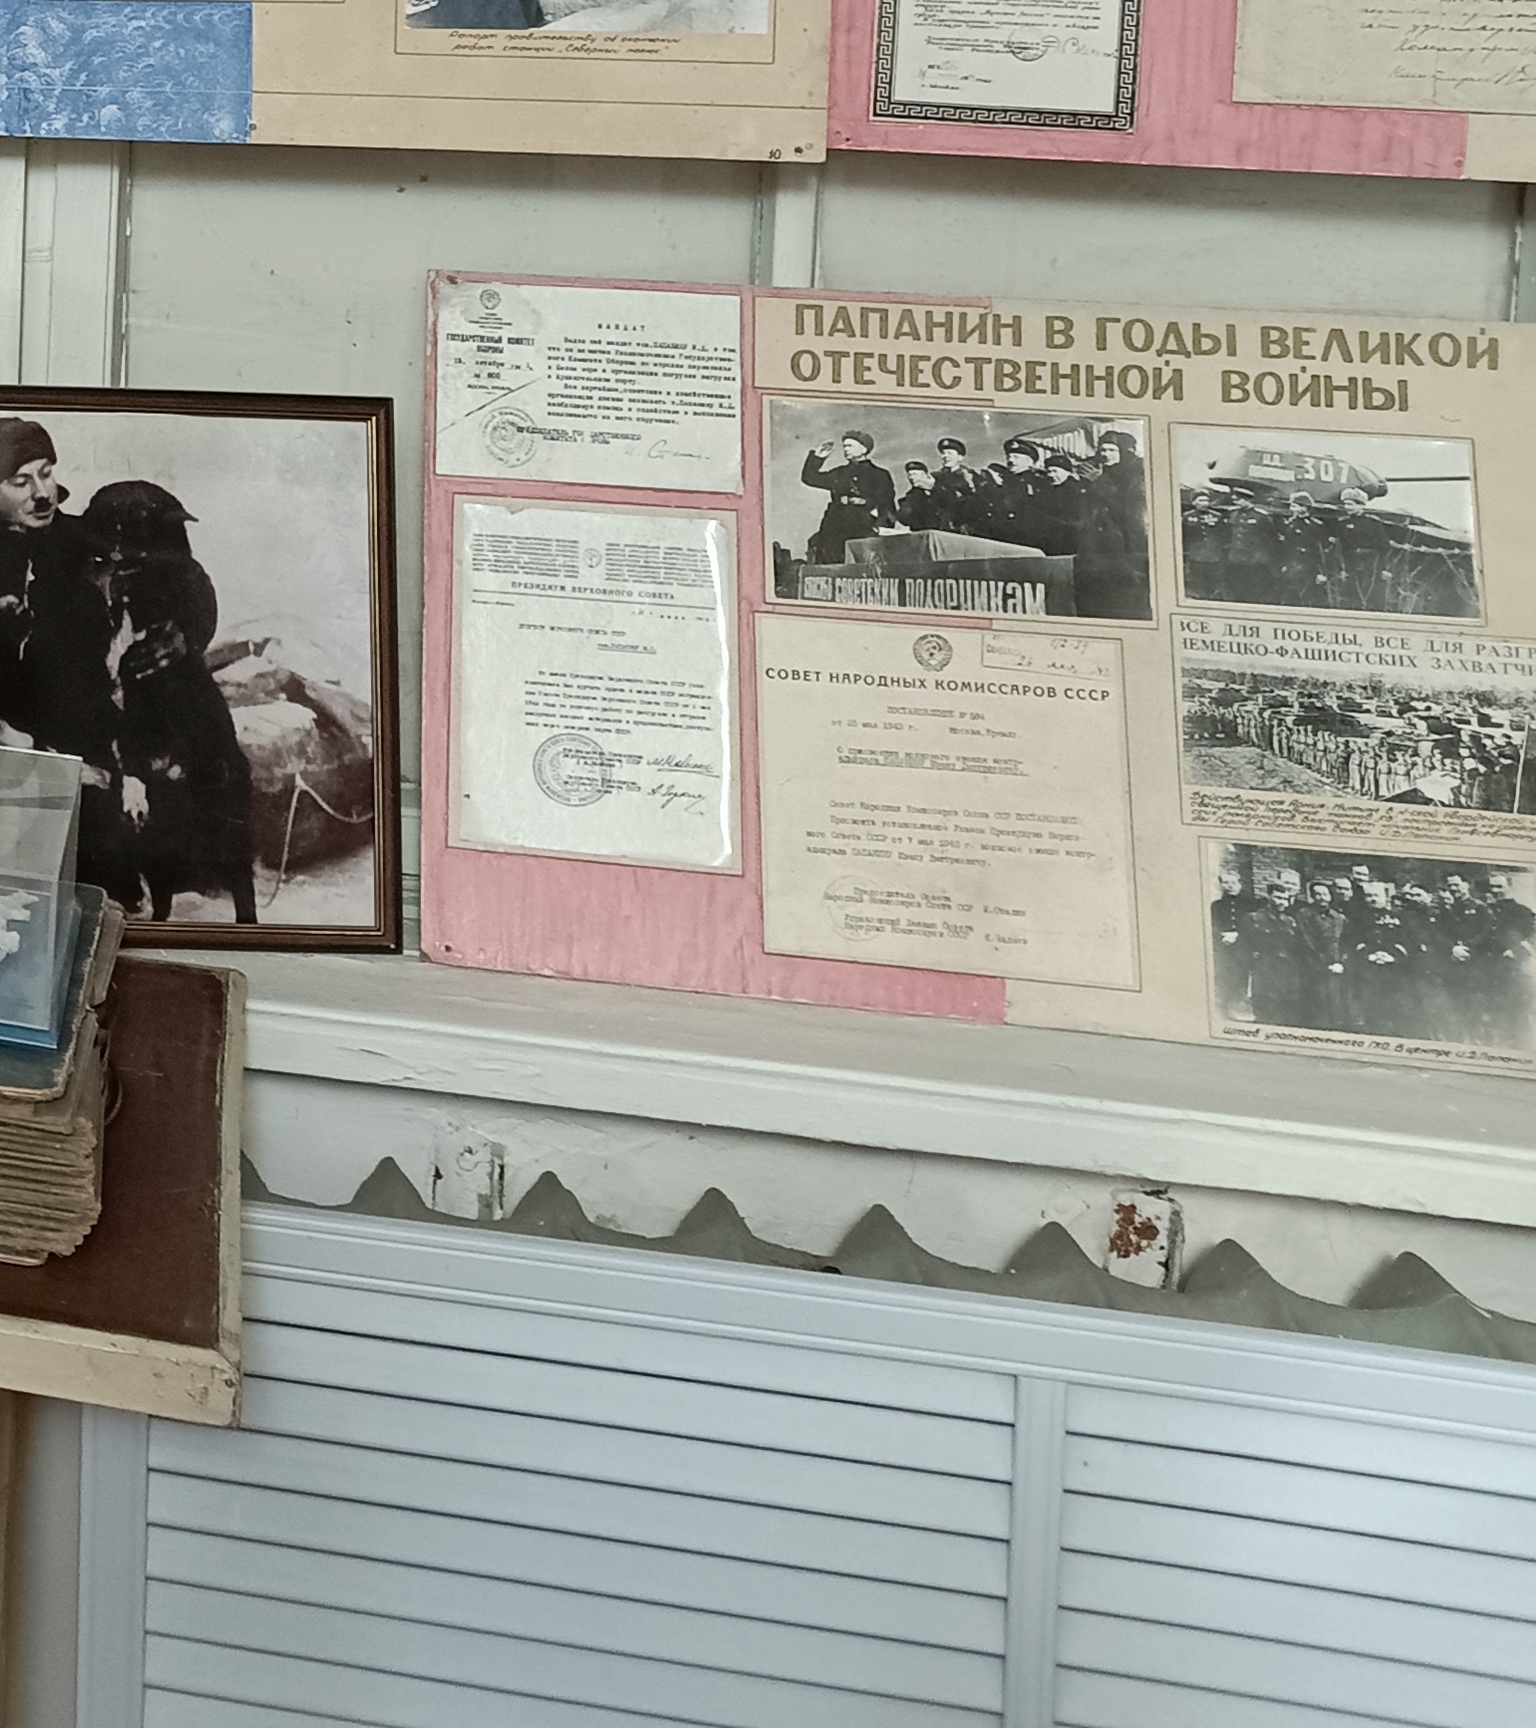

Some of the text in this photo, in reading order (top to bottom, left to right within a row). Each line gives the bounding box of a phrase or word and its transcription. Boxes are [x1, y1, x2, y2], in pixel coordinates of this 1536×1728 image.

[794, 303, 1500, 372] ПАПАНИН В ГОДЫ ВЕЛИКОЙ
[789, 349, 1184, 402] ОТЕЧЕСТВЕННОЙ
[1220, 363, 1410, 413] ВОЙНЫ
[511, 581, 675, 601] ПРЕЗИДИУМ ВЕРХОВНОГО СОВЕТА
[1221, 623, 1261, 640] ДЛЯ
[1272, 627, 1363, 648] ПОБЕДЫ,
[1374, 635, 1411, 651] ВСЕ
[1423, 639, 1465, 655] ДЛЯ
[765, 667, 1110, 701] СОВЕТ НАРОДНЫХ КОМИССАРОВ СССР
